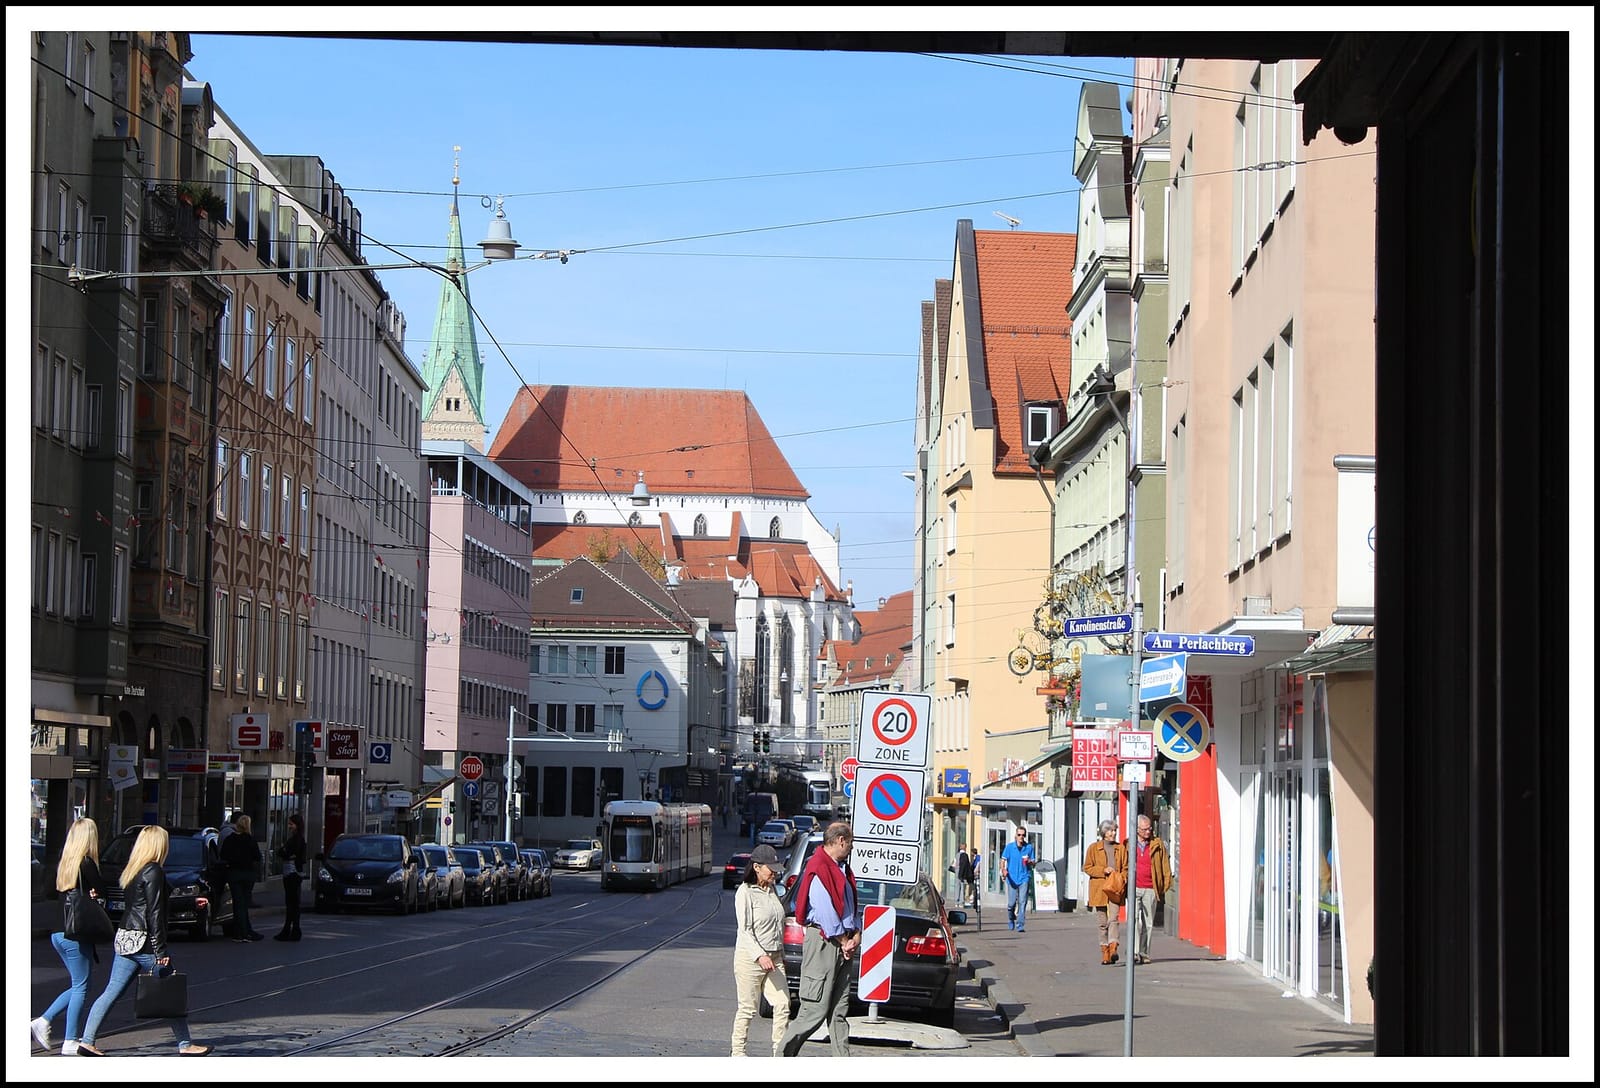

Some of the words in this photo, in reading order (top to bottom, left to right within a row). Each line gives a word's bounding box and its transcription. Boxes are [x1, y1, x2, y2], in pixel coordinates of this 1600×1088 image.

[1069, 616, 1126, 634] Karolinenstraße
[1151, 636, 1173, 649] Am
[1179, 636, 1246, 655] Perlachberg
[882, 711, 908, 733] 20
[331, 732, 352, 744] Stop
[336, 746, 357, 758] Shop
[874, 747, 910, 761] ZONE
[462, 763, 481, 774] STOP
[842, 763, 857, 774] STO
[1075, 767, 1114, 779] MEN
[869, 823, 904, 837] ZONE
[856, 847, 912, 863] werktags
[861, 863, 869, 874] 6
[885, 864, 904, 877] 18h
